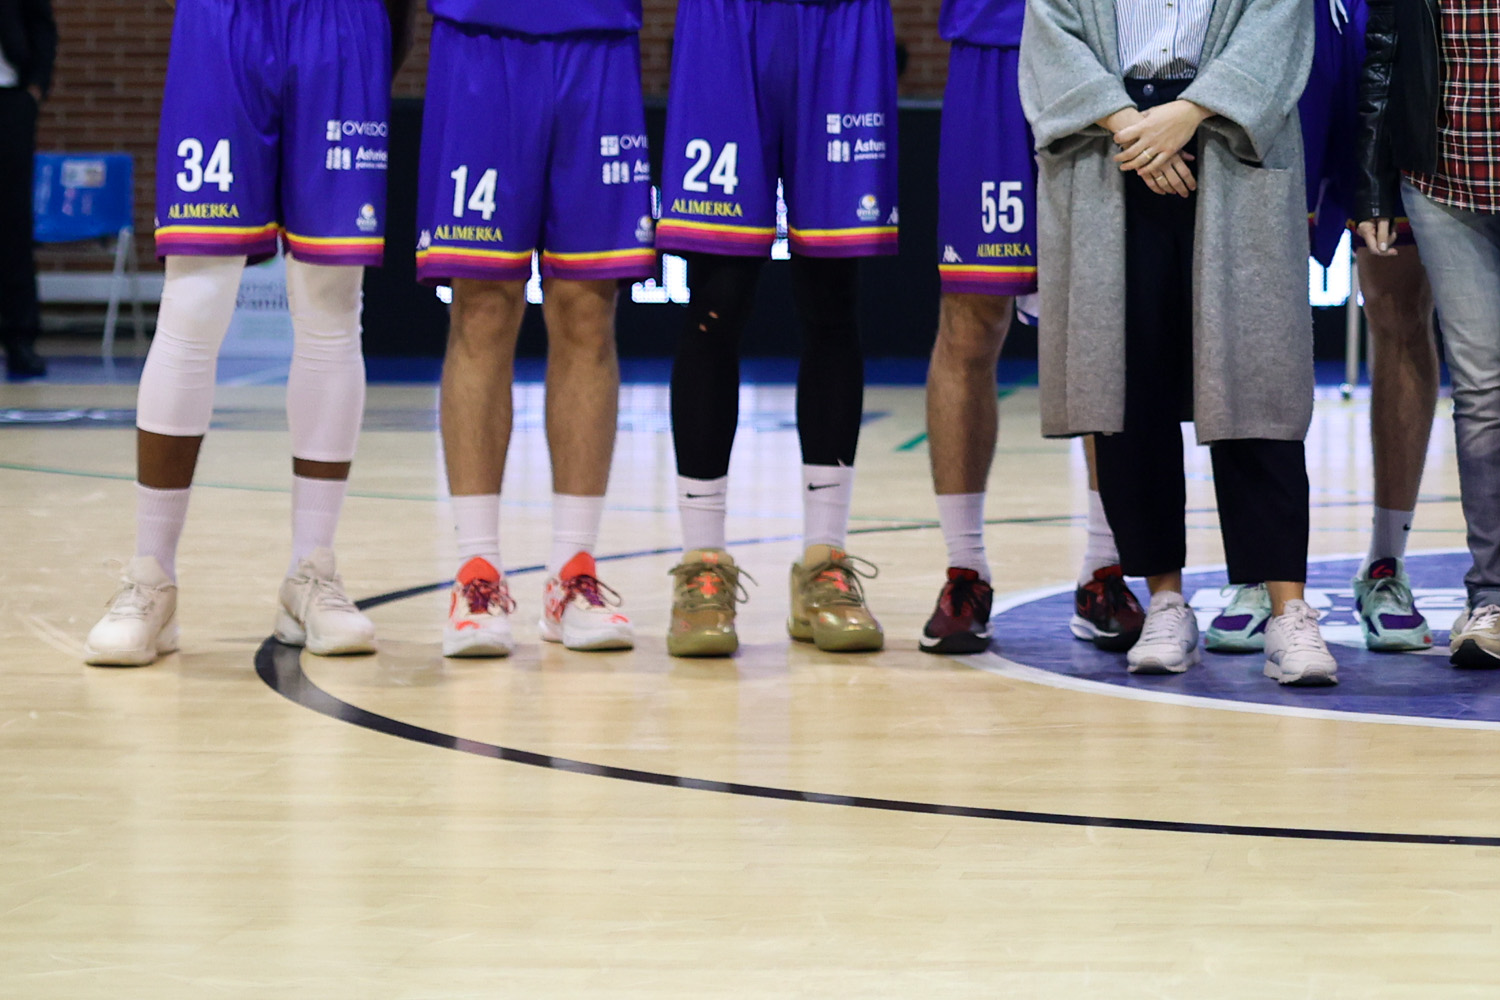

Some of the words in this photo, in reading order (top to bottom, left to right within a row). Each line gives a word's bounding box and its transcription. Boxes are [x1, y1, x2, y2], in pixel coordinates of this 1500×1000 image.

[176, 137, 234, 193] 34
[682, 138, 739, 195] 24
[167, 202, 240, 219] ALIMERKA
[450, 165, 498, 221] 14
[671, 198, 743, 218] ALIMERKA
[981, 181, 1025, 234] 55
[433, 224, 503, 242] ALIMERKA
